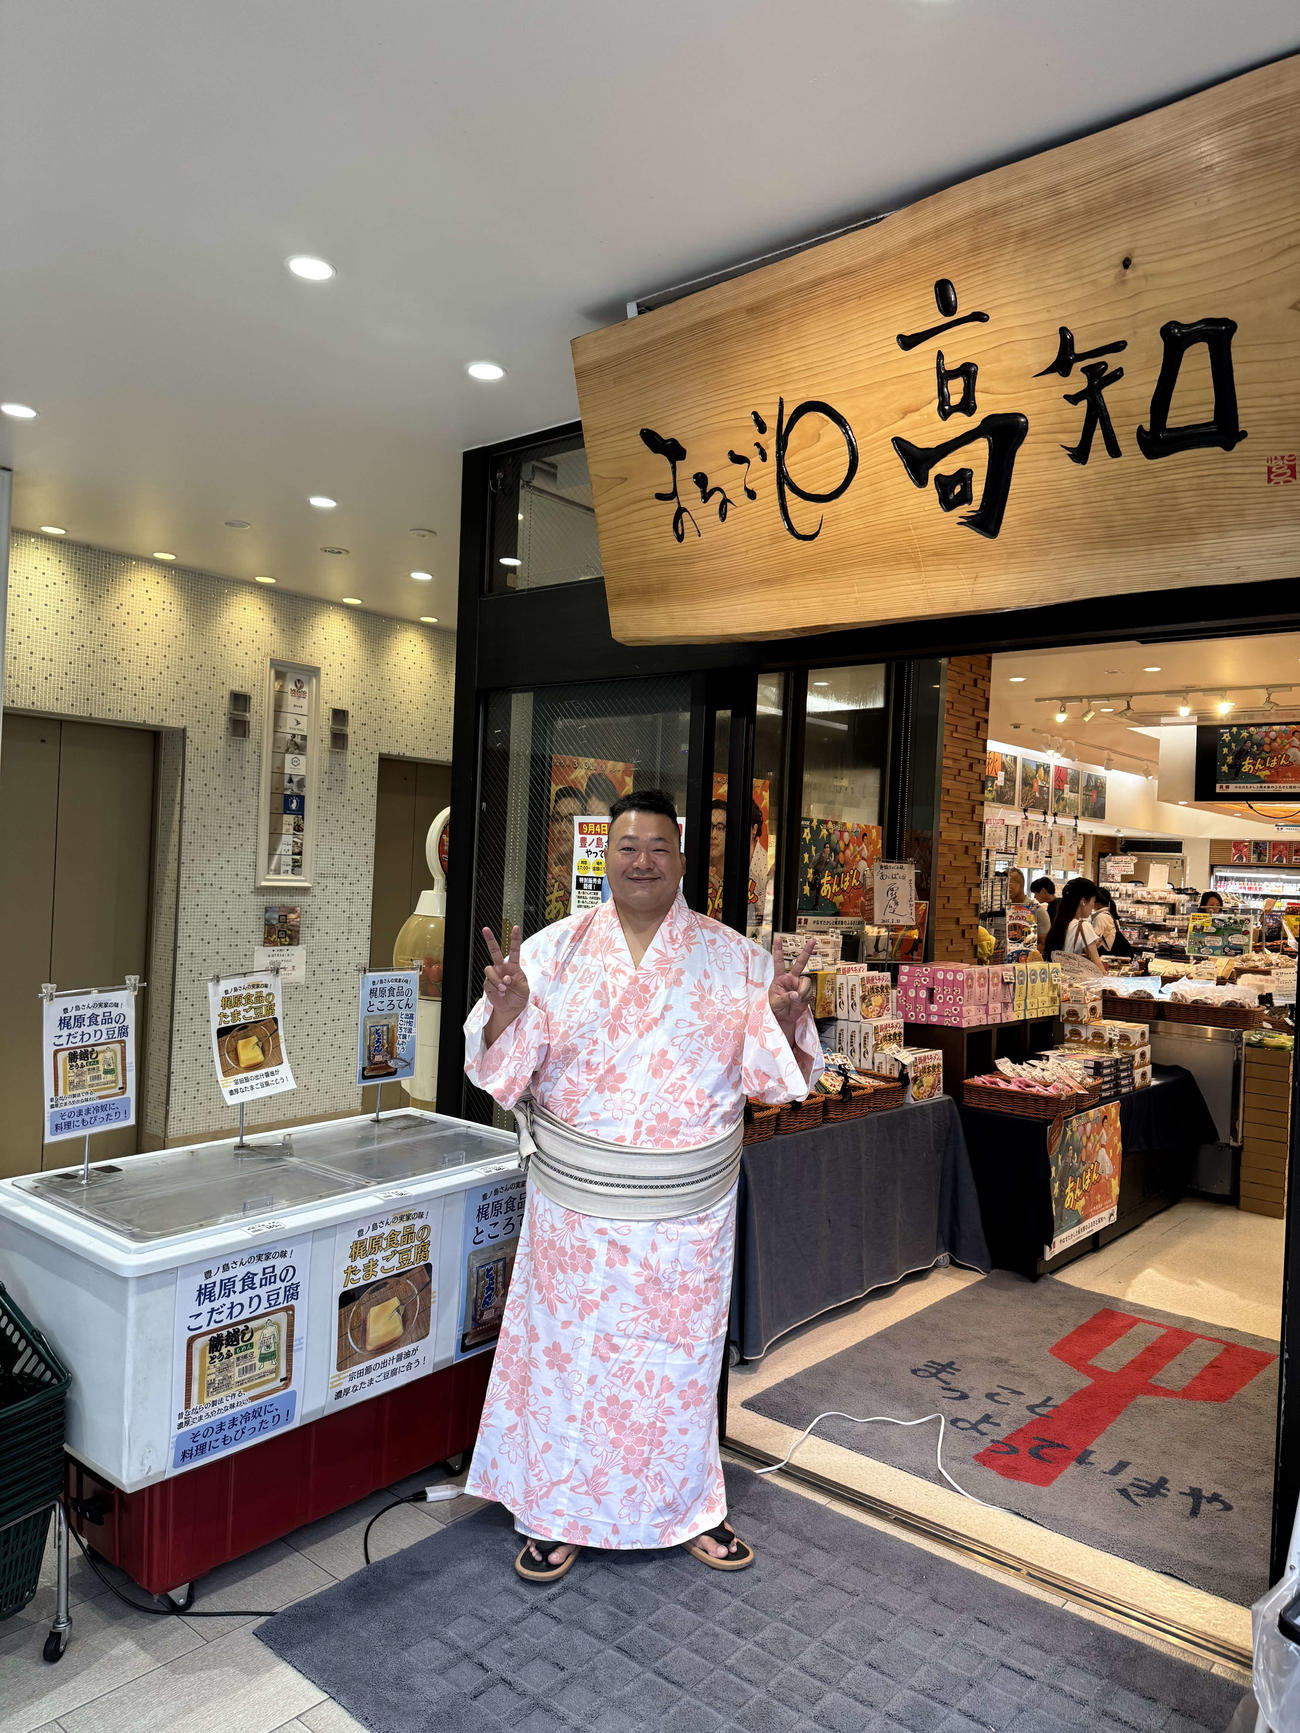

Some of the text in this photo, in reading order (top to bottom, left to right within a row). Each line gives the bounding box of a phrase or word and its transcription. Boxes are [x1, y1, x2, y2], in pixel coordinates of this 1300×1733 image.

[1241, 753, 1290, 774] あんぱん
[582, 823, 609, 835] 9月4日
[820, 869, 861, 899] あんぱん
[220, 990, 275, 1011] 梶原食品の
[366, 998, 413, 1013] ところてん
[369, 986, 413, 999] 梶原食品の
[58, 1011, 126, 1031] 梶原食品の
[218, 1002, 276, 1025] たまご豆腐
[53, 1024, 129, 1047] こだわり豆腐
[1064, 1160, 1101, 1210] あんぱん
[357, 1211, 429, 1238] 豊ノ島さんの実家の味！
[349, 1224, 431, 1262] 梶原食品の
[204, 1249, 293, 1280] 豊ノ島さんの実家の味！
[343, 1240, 431, 1288] たまご豆腐
[195, 1265, 296, 1307] 梶原食品の
[187, 1282, 301, 1332] こだわり豆腐
[208, 1325, 254, 1354] 勝越し
[208, 1350, 233, 1364] とうふ
[348, 1346, 419, 1382] 宗田節の出汁醤油が
[334, 1356, 427, 1400] 濃厚なたまご豆腐に合う！
[910, 1360, 1059, 1420] まっこと
[190, 1403, 279, 1444] そのまま冷奴に、
